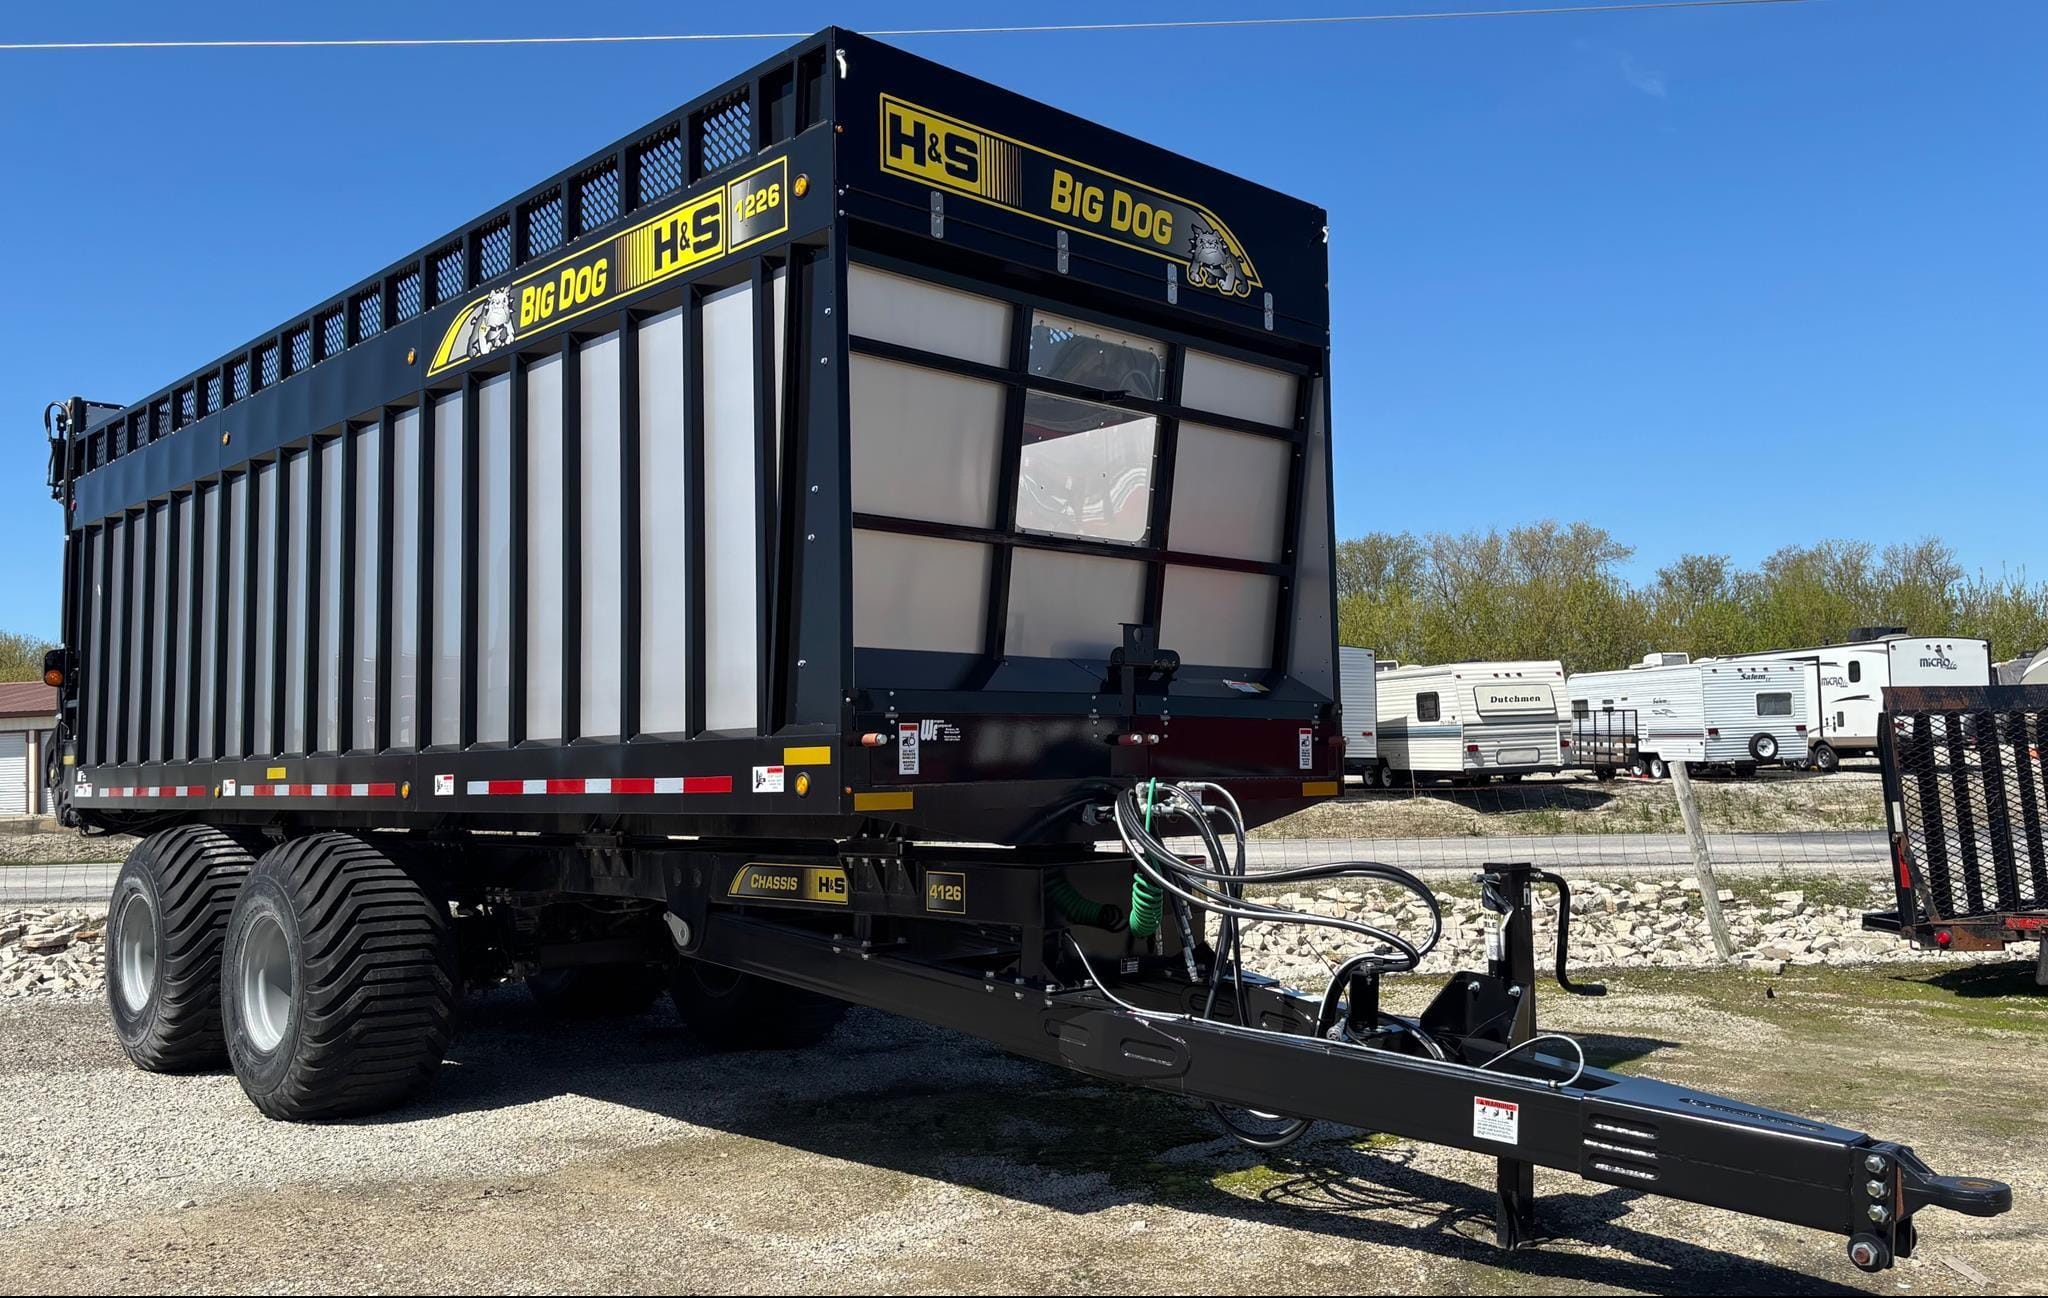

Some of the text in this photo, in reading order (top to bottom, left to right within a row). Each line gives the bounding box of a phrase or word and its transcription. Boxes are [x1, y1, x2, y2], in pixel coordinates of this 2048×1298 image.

[889, 112, 979, 183] H&S
[734, 183, 781, 223] 1226
[1050, 168, 1174, 246] BIG DOG
[654, 202, 721, 271] H&S
[519, 257, 608, 328] BIG DOG
[1490, 695, 1541, 704] Dutchmen
[750, 873, 798, 891] CHASSIS
[818, 876, 846, 895] H&S
[929, 884, 962, 901] 4126
